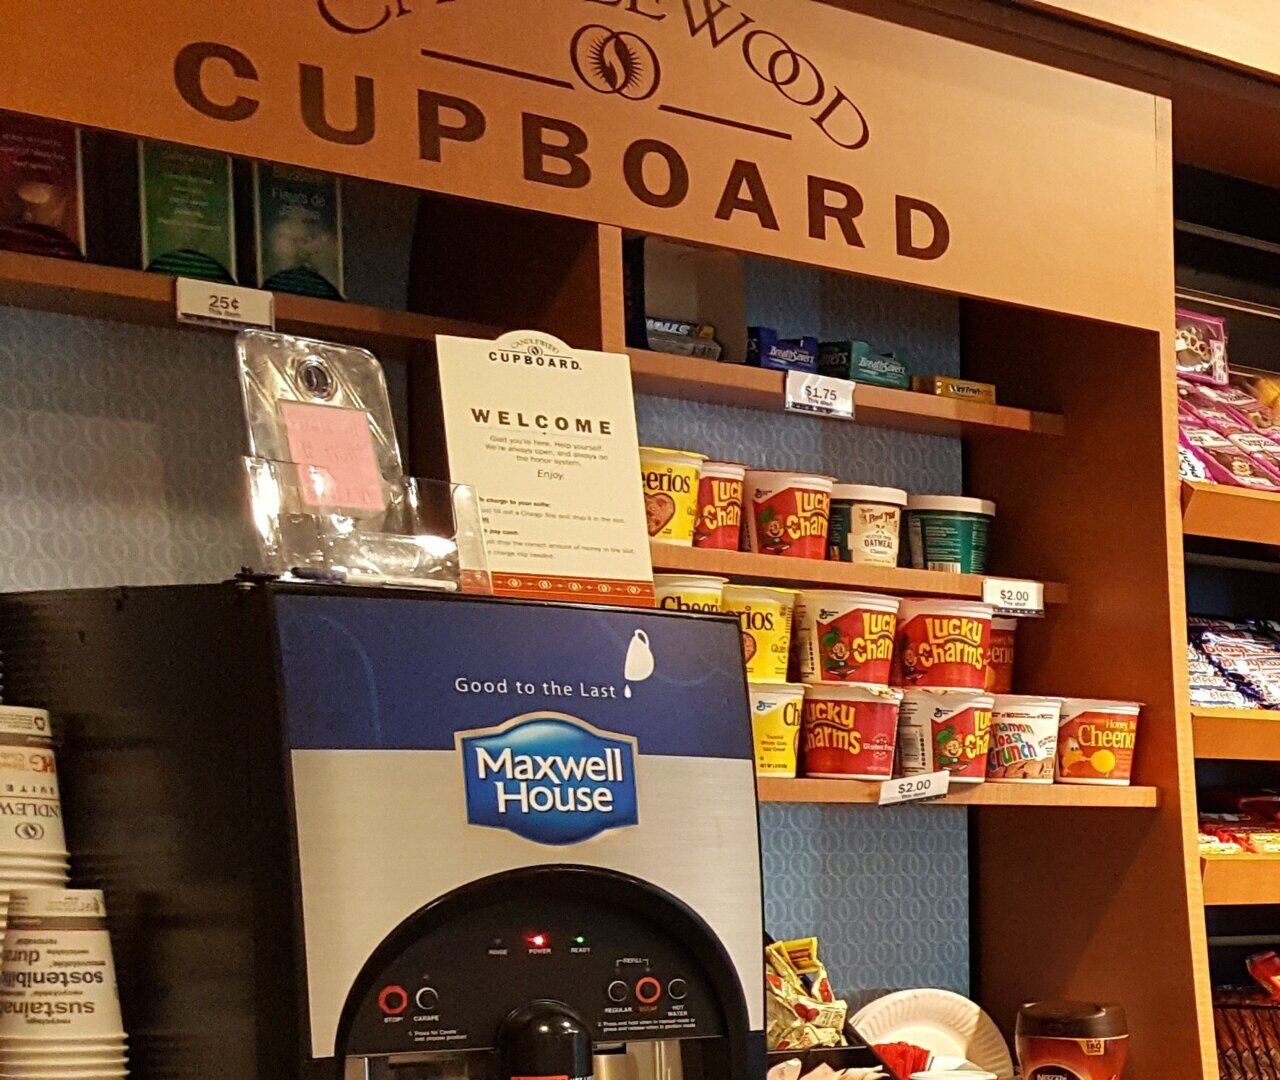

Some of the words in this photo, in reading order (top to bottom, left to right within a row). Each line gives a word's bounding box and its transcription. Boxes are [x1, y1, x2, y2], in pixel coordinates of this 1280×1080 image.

[173, 41, 951, 260] CUPBOARD
[208, 294, 241, 310] 25¢
[804, 386, 838, 401] $1.75
[470, 408, 613, 435] WELCOME
[864, 539, 893, 549] OATMEAL
[999, 590, 1030, 602] $2.00
[926, 617, 984, 646] Lucky
[920, 638, 985, 668] Charms
[454, 676, 508, 694] Good
[515, 680, 535, 696] to
[542, 680, 573, 698] the
[579, 682, 617, 699] Last
[474, 746, 624, 784] Maxwell
[494, 780, 615, 815] House
[898, 778, 931, 794] $2.00
[604, 1006, 633, 1014] REGULAR
